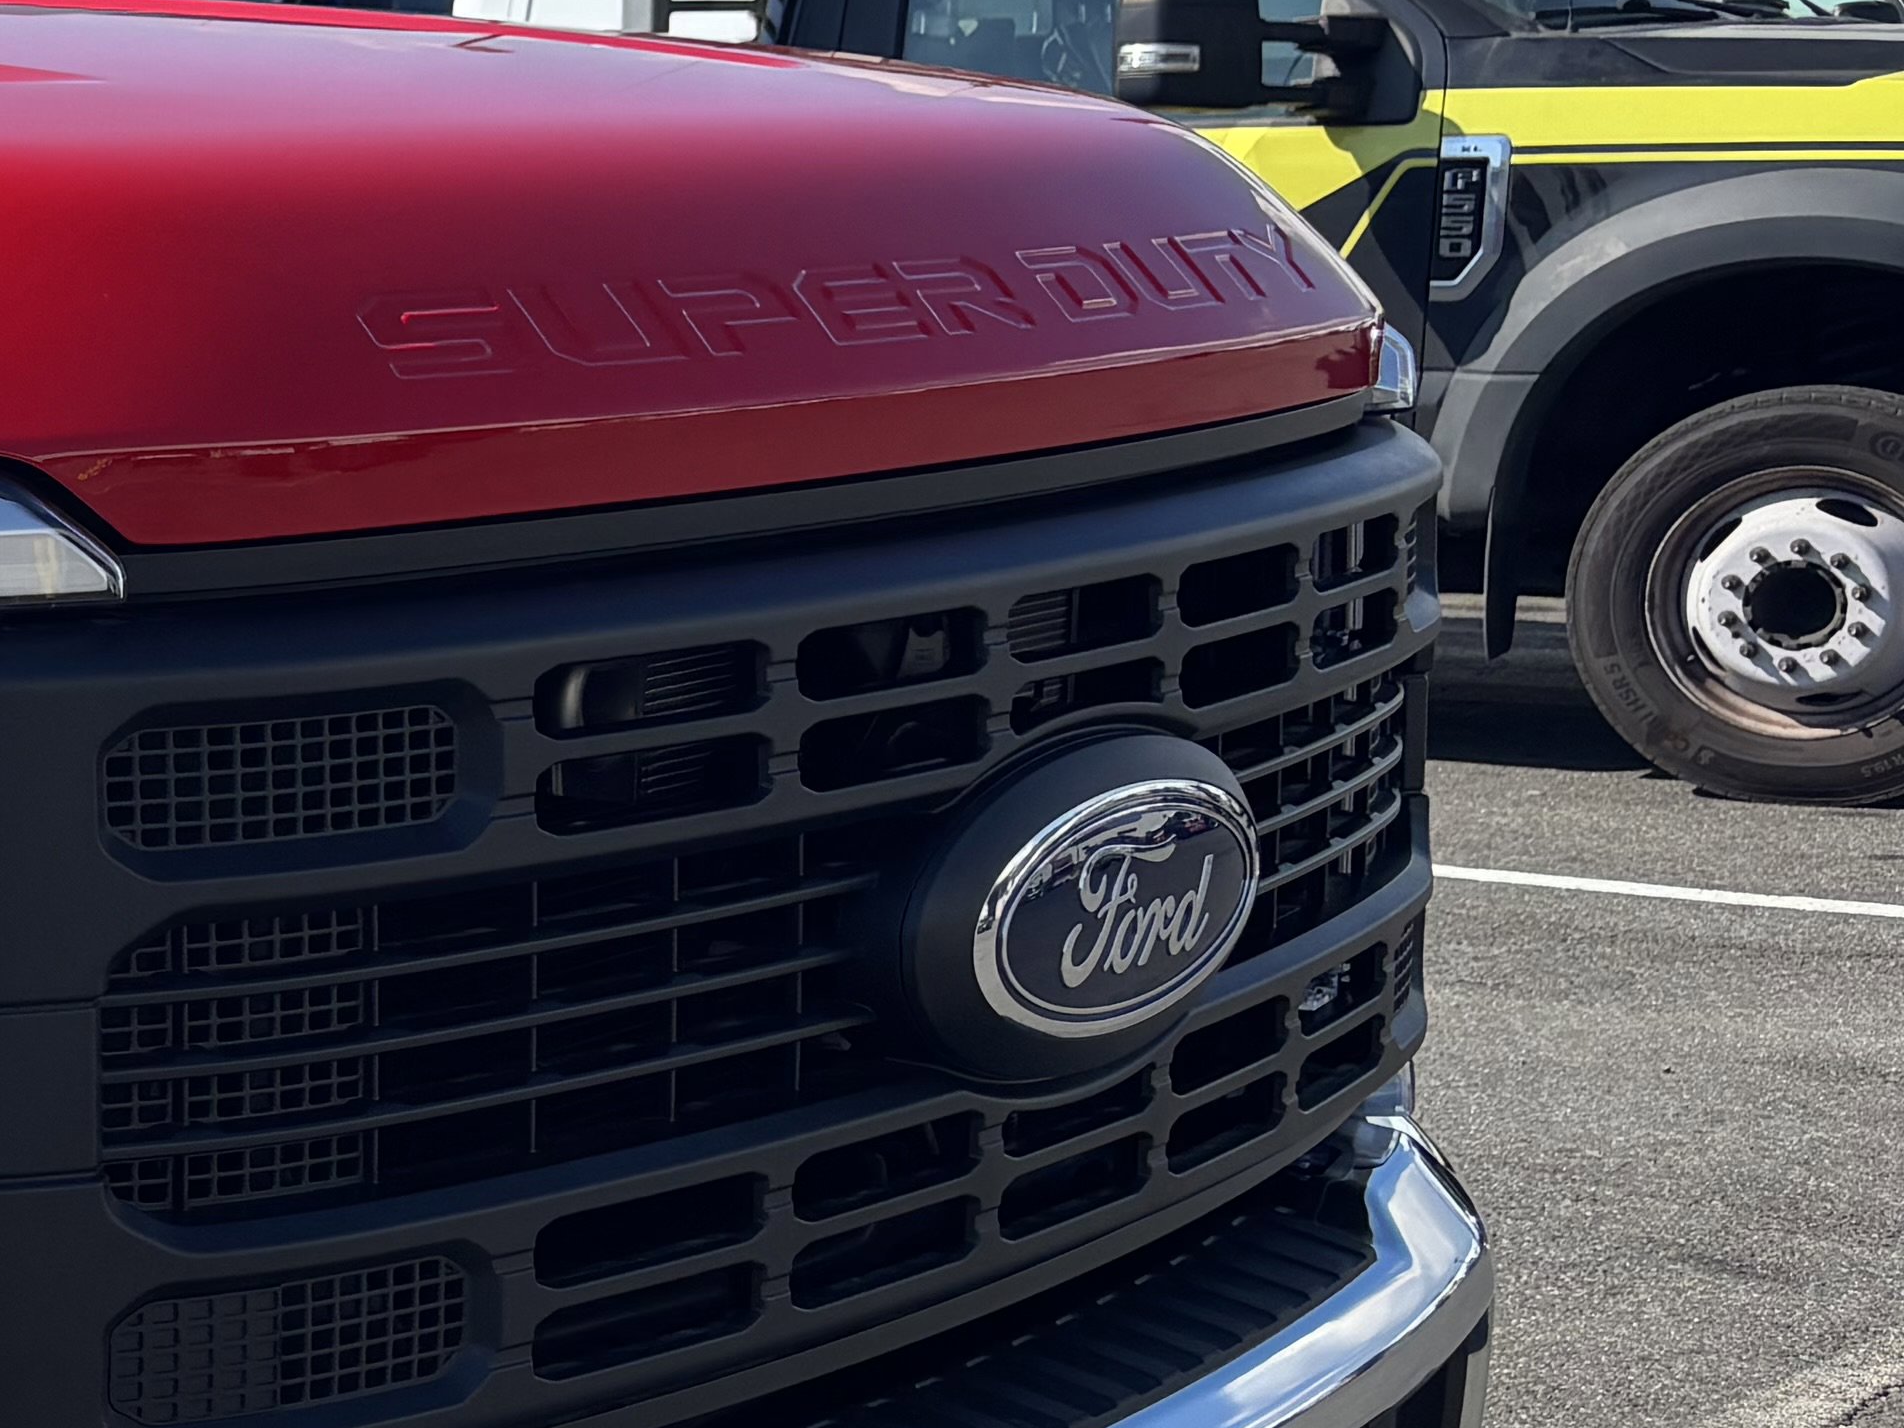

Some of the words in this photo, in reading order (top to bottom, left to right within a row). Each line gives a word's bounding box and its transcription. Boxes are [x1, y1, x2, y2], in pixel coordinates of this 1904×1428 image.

[1439, 168, 1481, 258] F550
[356, 258, 1033, 380] SUPER
[1016, 222, 1318, 324] DUTY
[1061, 833, 1214, 988] Ford
